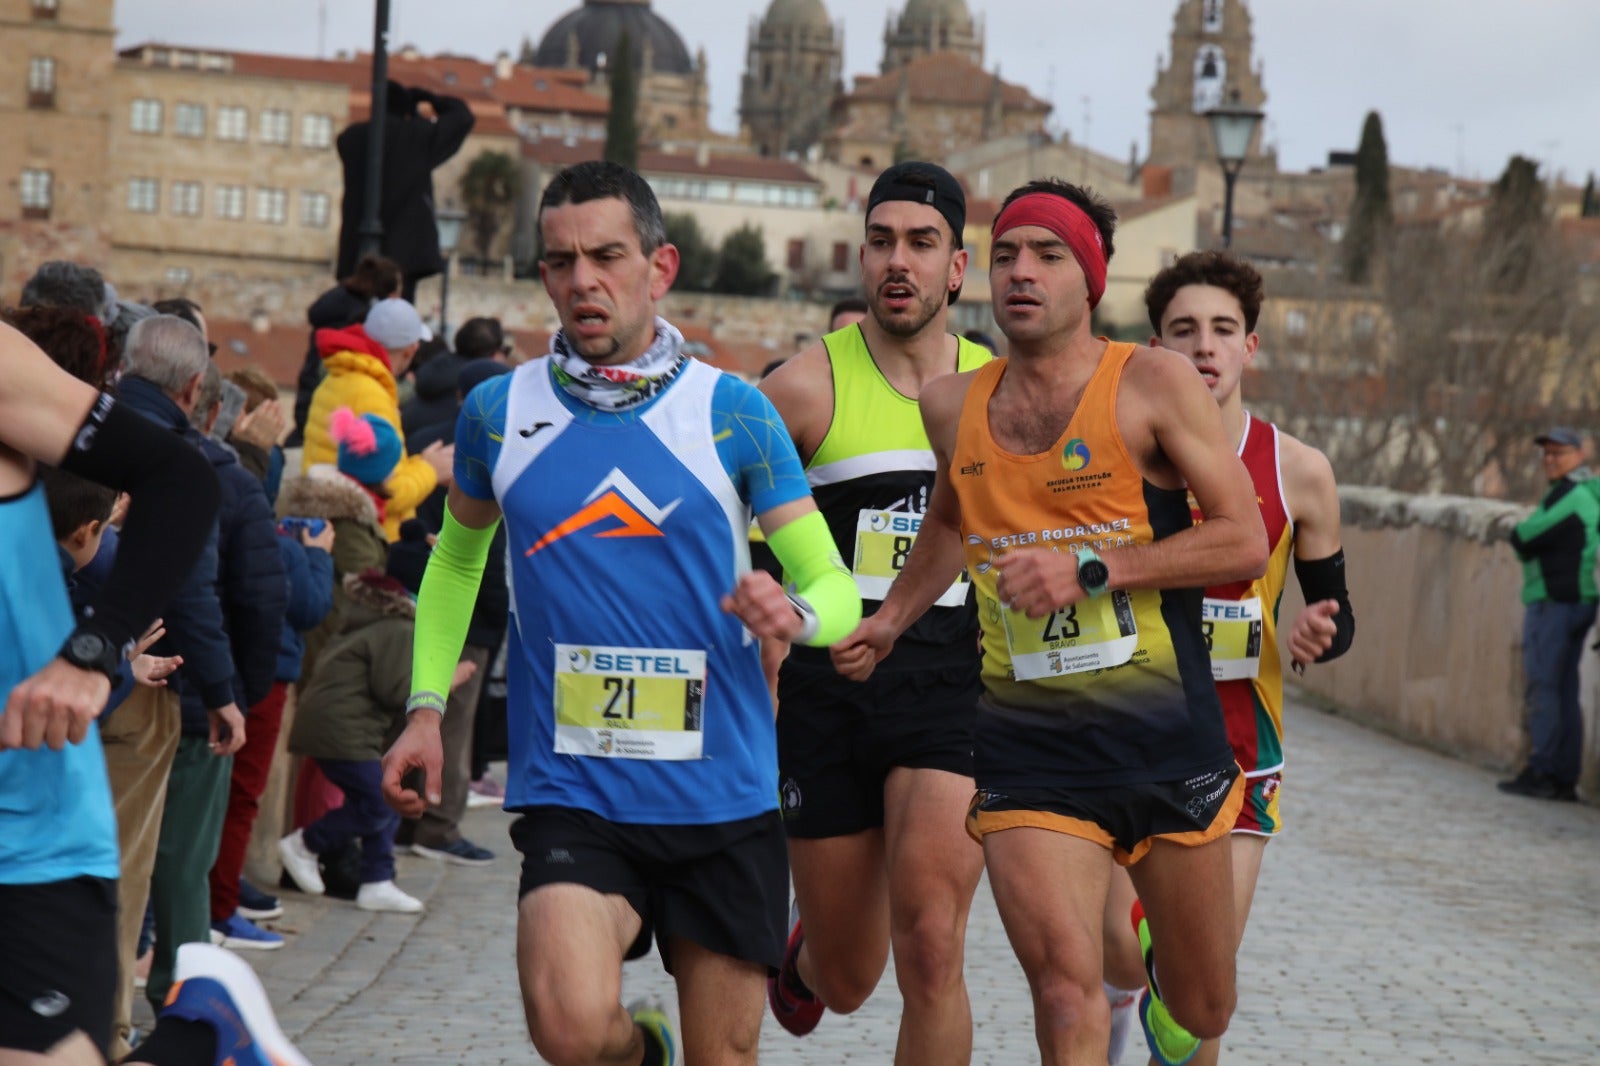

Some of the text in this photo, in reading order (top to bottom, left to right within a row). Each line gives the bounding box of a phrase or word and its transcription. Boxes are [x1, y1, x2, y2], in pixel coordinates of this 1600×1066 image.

[991, 531, 1037, 549] ESTER
[1042, 603, 1080, 642] 23
[1049, 638, 1077, 650] BRAVO
[594, 653, 690, 674] SETEL
[602, 676, 635, 720] 21
